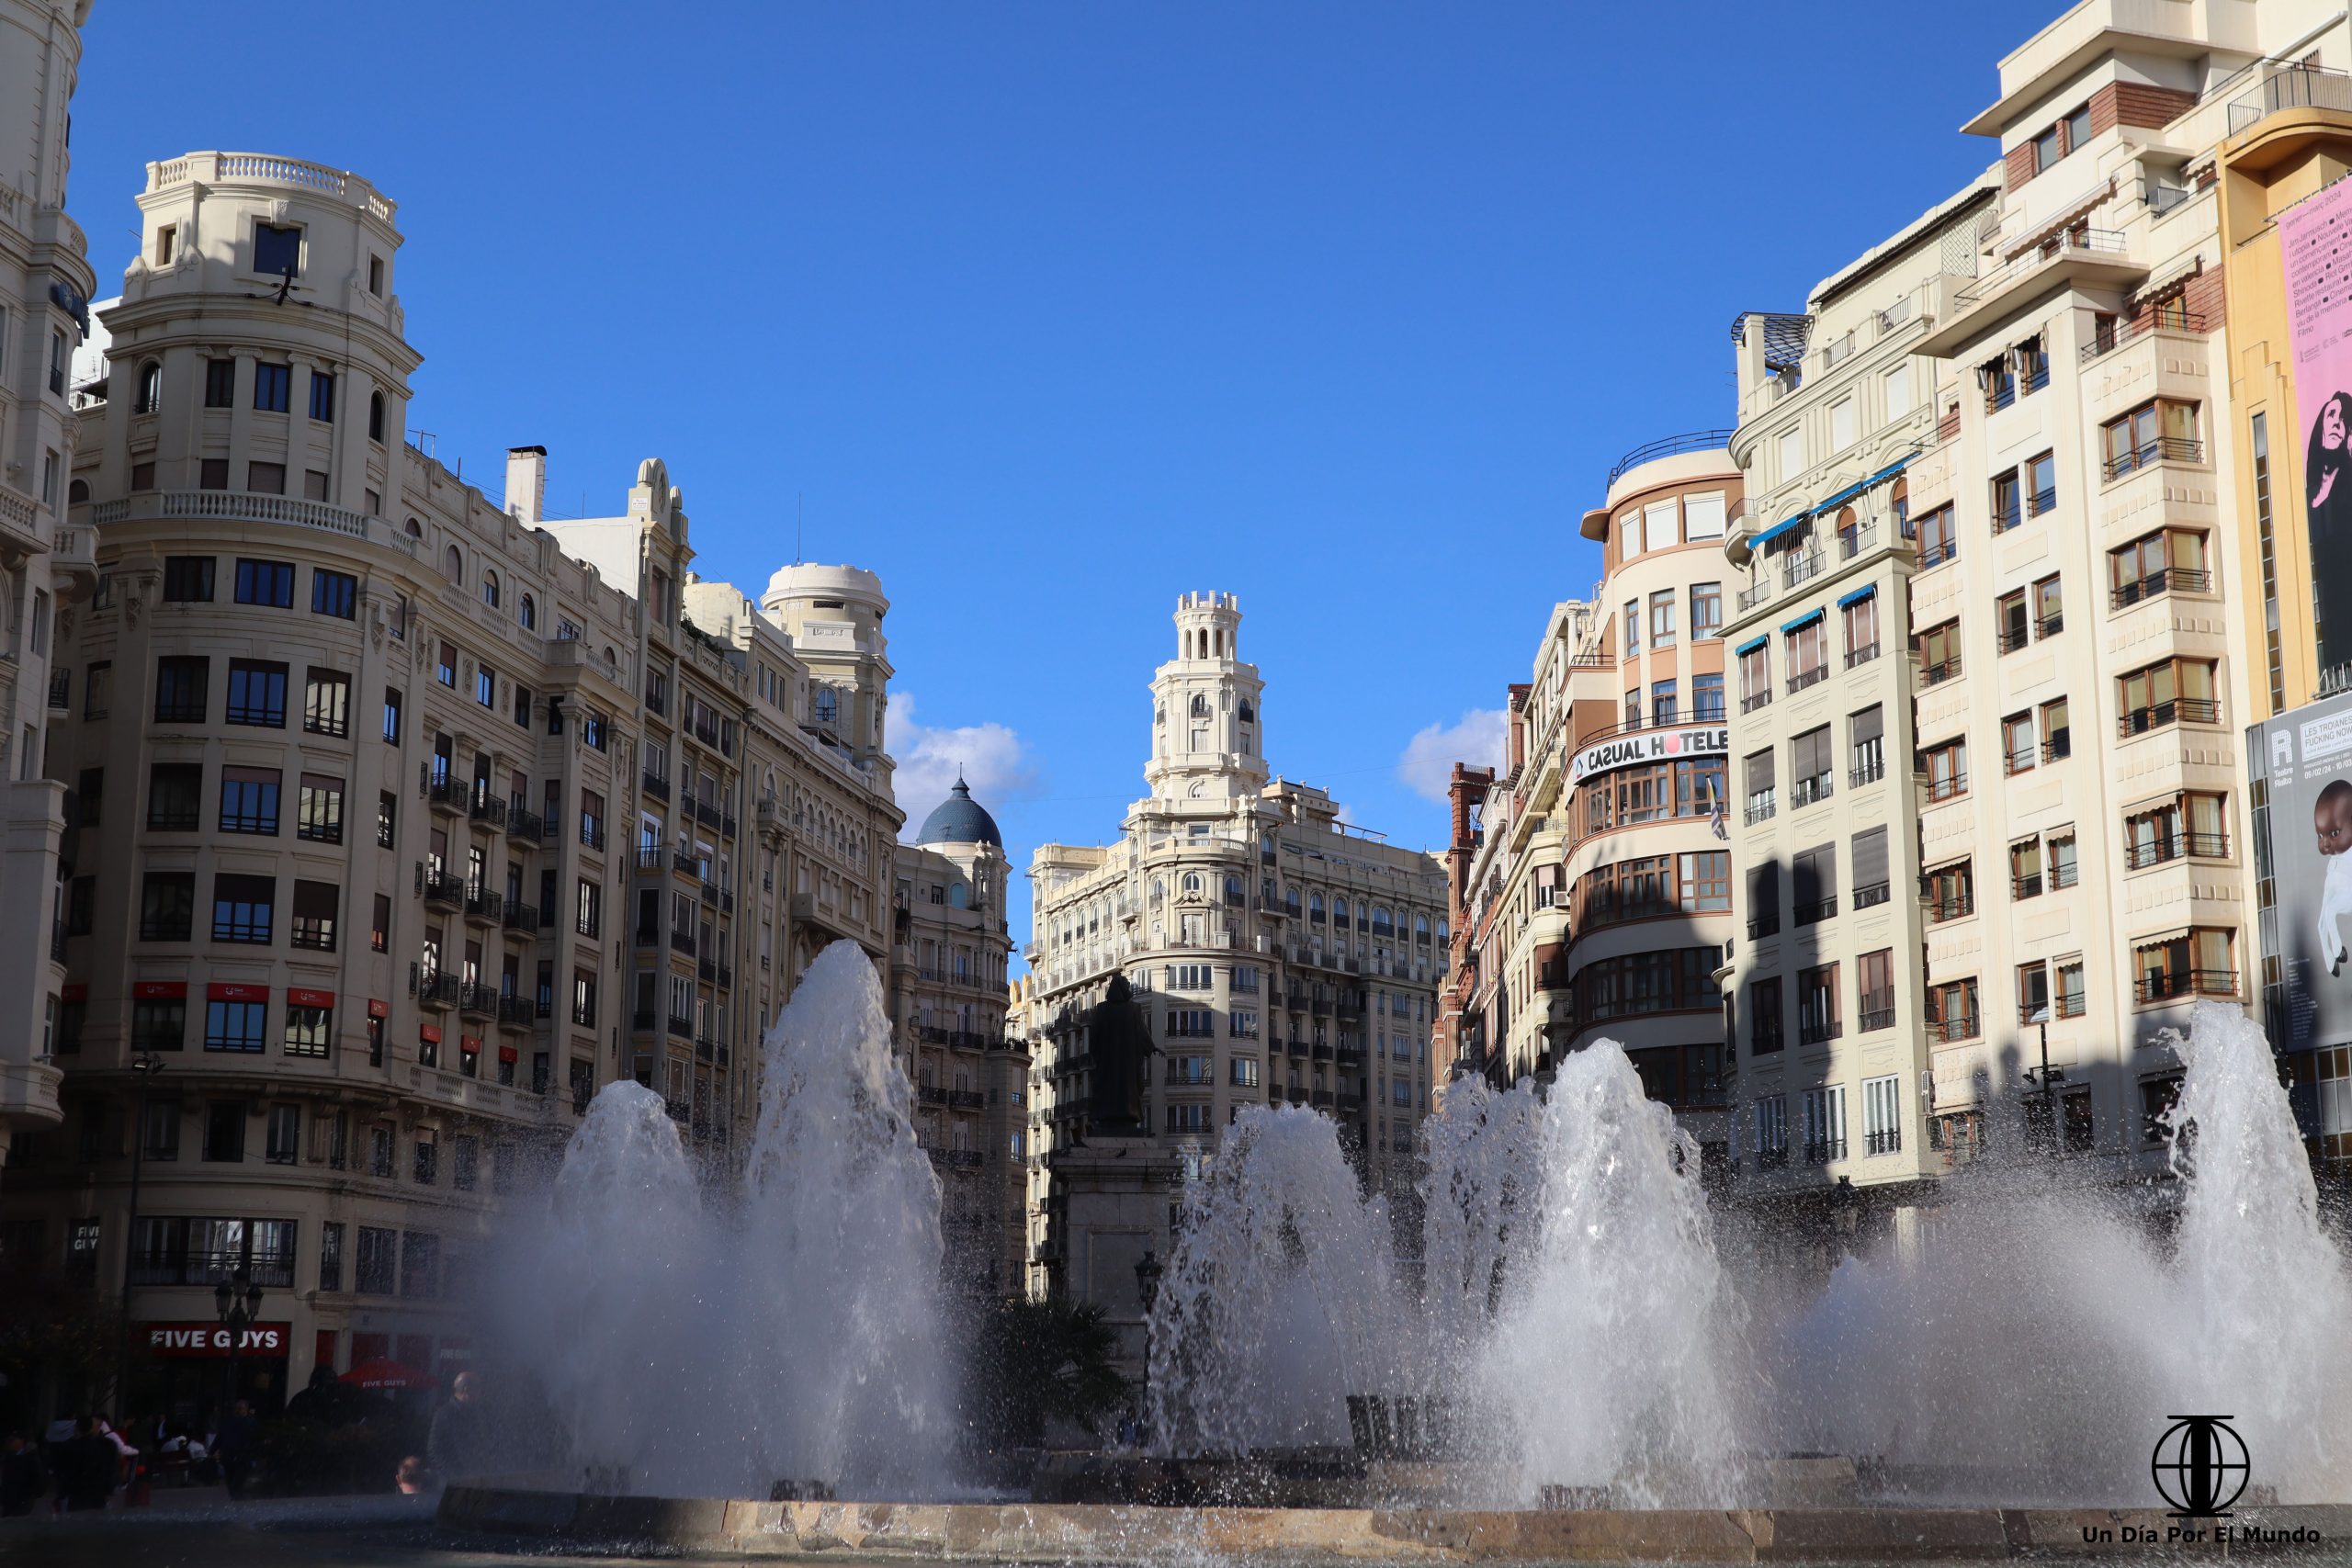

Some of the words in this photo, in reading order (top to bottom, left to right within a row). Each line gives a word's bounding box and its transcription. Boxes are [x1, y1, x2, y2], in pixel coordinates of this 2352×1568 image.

[2325, 190, 2341, 206] 2024
[2289, 239, 2299, 248] Jim
[2300, 220, 2328, 243] Jarmusch
[2292, 243, 2310, 257] utopia
[2317, 223, 2344, 242] Nouvelle
[2299, 234, 2341, 264] començament
[2291, 252, 2332, 278] contemporani
[2293, 281, 2317, 299] Shinoda
[2325, 269, 2337, 281] Riot
[2295, 293, 2315, 309] Rivette
[2315, 277, 2342, 296] restaurat
[2296, 299, 2322, 319] Berlanga
[2297, 320, 2306, 328] viu
[2298, 325, 2314, 338] Filmo
[2305, 727, 2318, 738] LES
[2305, 731, 2335, 748] FUCKING
[1589, 739, 1645, 771] CASUAL
[2274, 767, 2294, 778] Teatre
[2274, 777, 2292, 789] Rialto
[150, 1330, 207, 1348] FIVE
